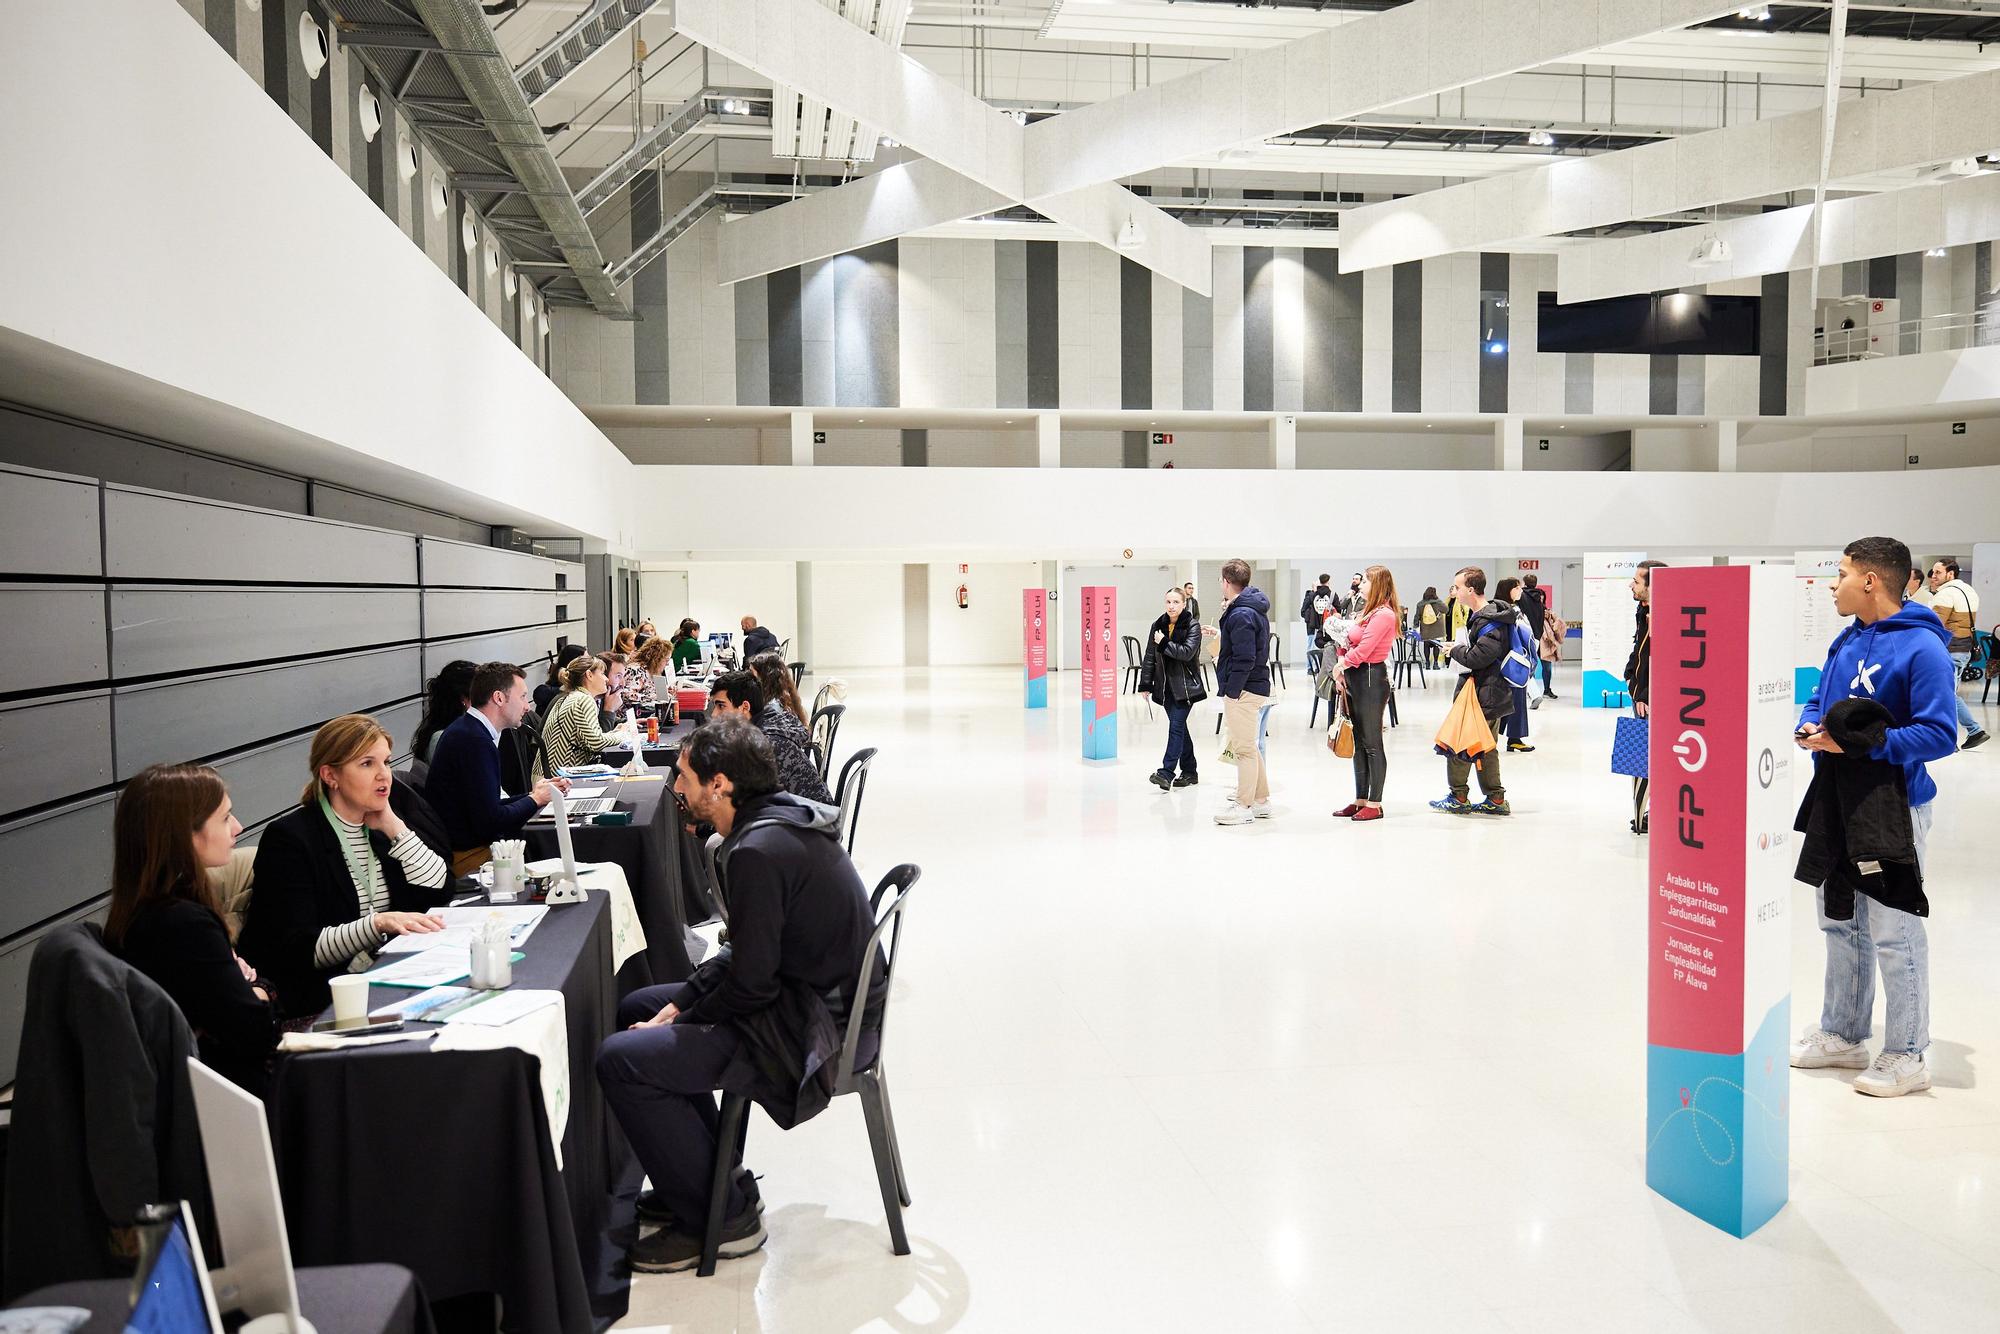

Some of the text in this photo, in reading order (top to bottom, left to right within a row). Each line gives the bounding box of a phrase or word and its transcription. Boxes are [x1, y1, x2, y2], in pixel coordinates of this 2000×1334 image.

[1672, 605, 1708, 850] FP ON LH
[1666, 872, 1719, 896] Arabako LHko
[1659, 885, 1728, 915] Enplegagarritasun
[1667, 904, 1717, 928] Jardunaldiak
[1666, 935, 1714, 960] Jornadas de
[1664, 950, 1717, 978] Empleabilidad
[1673, 968, 1708, 991] FP Álava
